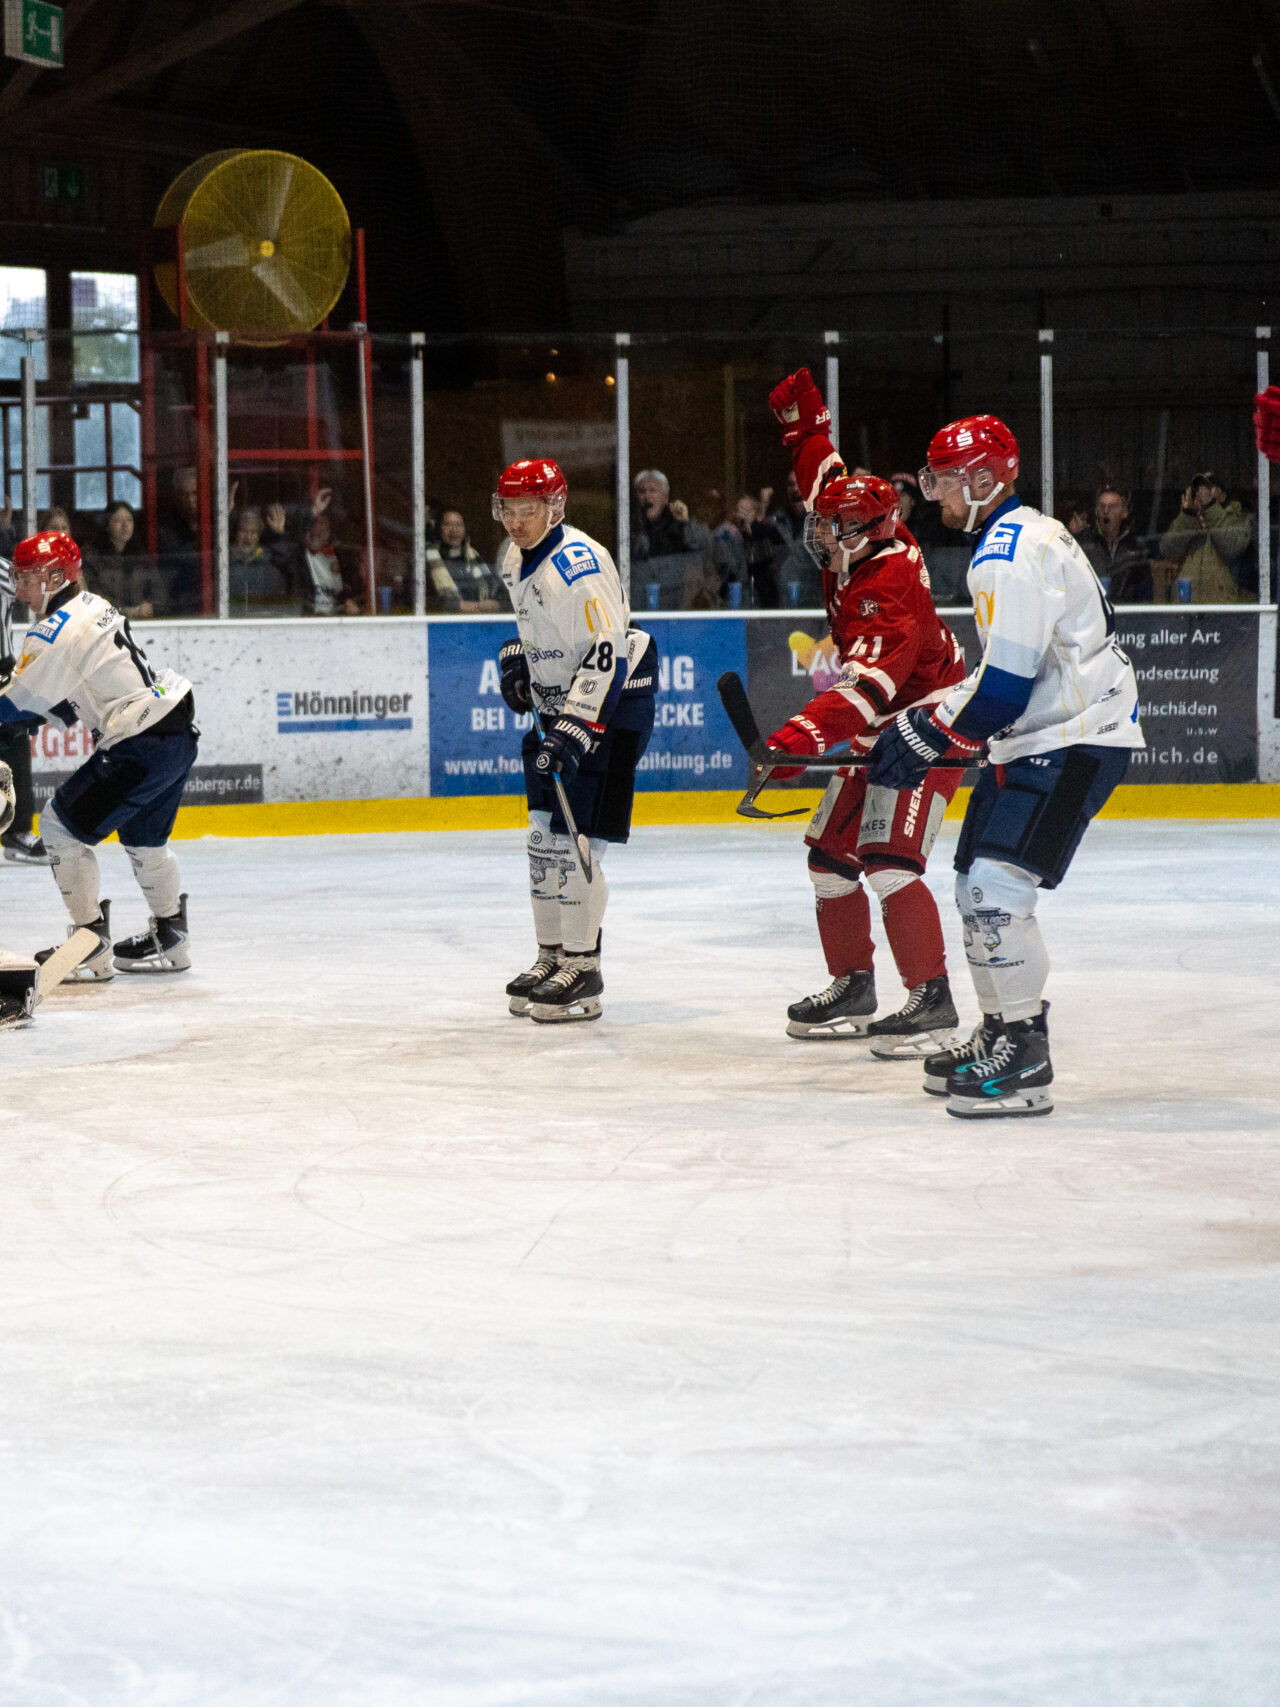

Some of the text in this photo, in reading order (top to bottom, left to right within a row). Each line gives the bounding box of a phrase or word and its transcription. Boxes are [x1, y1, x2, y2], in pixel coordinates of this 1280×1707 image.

[1115, 629, 1221, 649] ung aller Art
[582, 640, 614, 673] 28
[622, 676, 653, 690] RRIOR
[1135, 665, 1220, 684] ndsetzung
[294, 690, 413, 719] Hönninger
[1138, 701, 1218, 716] elschäden
[472, 707, 506, 731] BEI
[1131, 746, 1219, 764] mich.de
[183, 774, 261, 795] sberger.de
